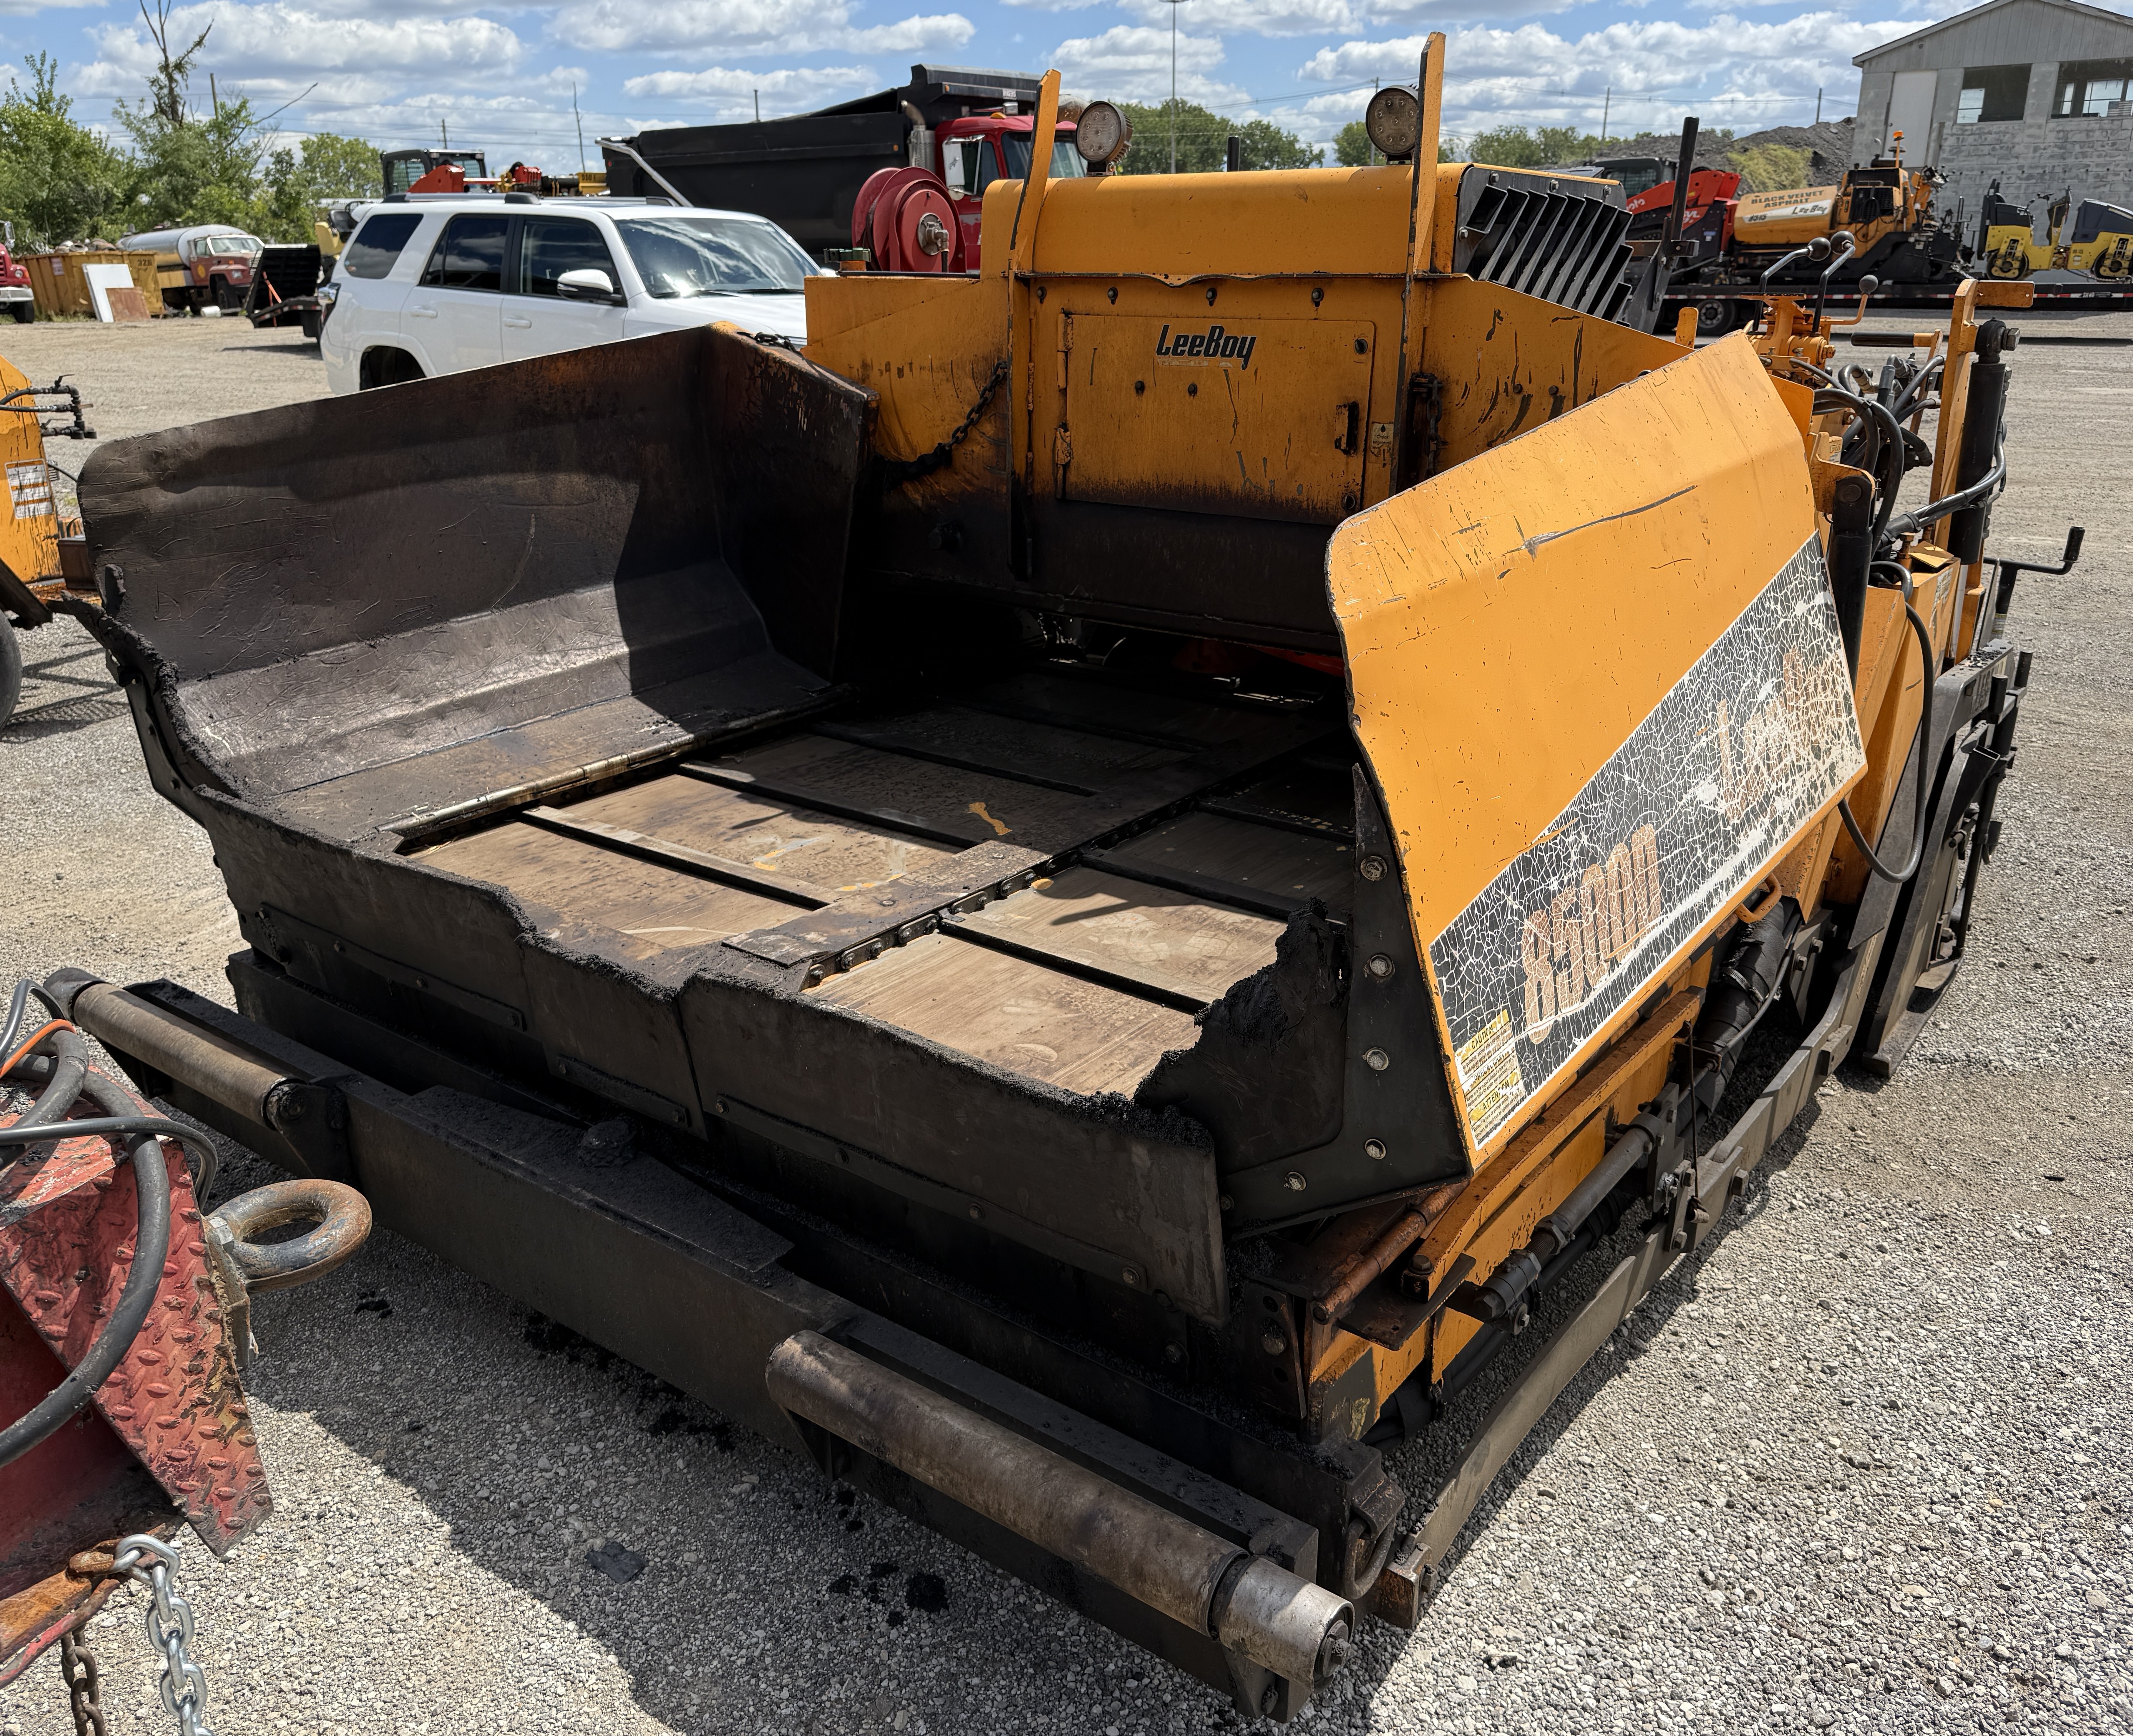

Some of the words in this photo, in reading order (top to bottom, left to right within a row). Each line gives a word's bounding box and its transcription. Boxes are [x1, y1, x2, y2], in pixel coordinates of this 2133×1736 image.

[1751, 195, 1785, 204] BLACK
[1787, 190, 1824, 199] VELVET
[1764, 198, 1810, 208] ASPHALT
[1156, 323, 1257, 371] LeeBoy
